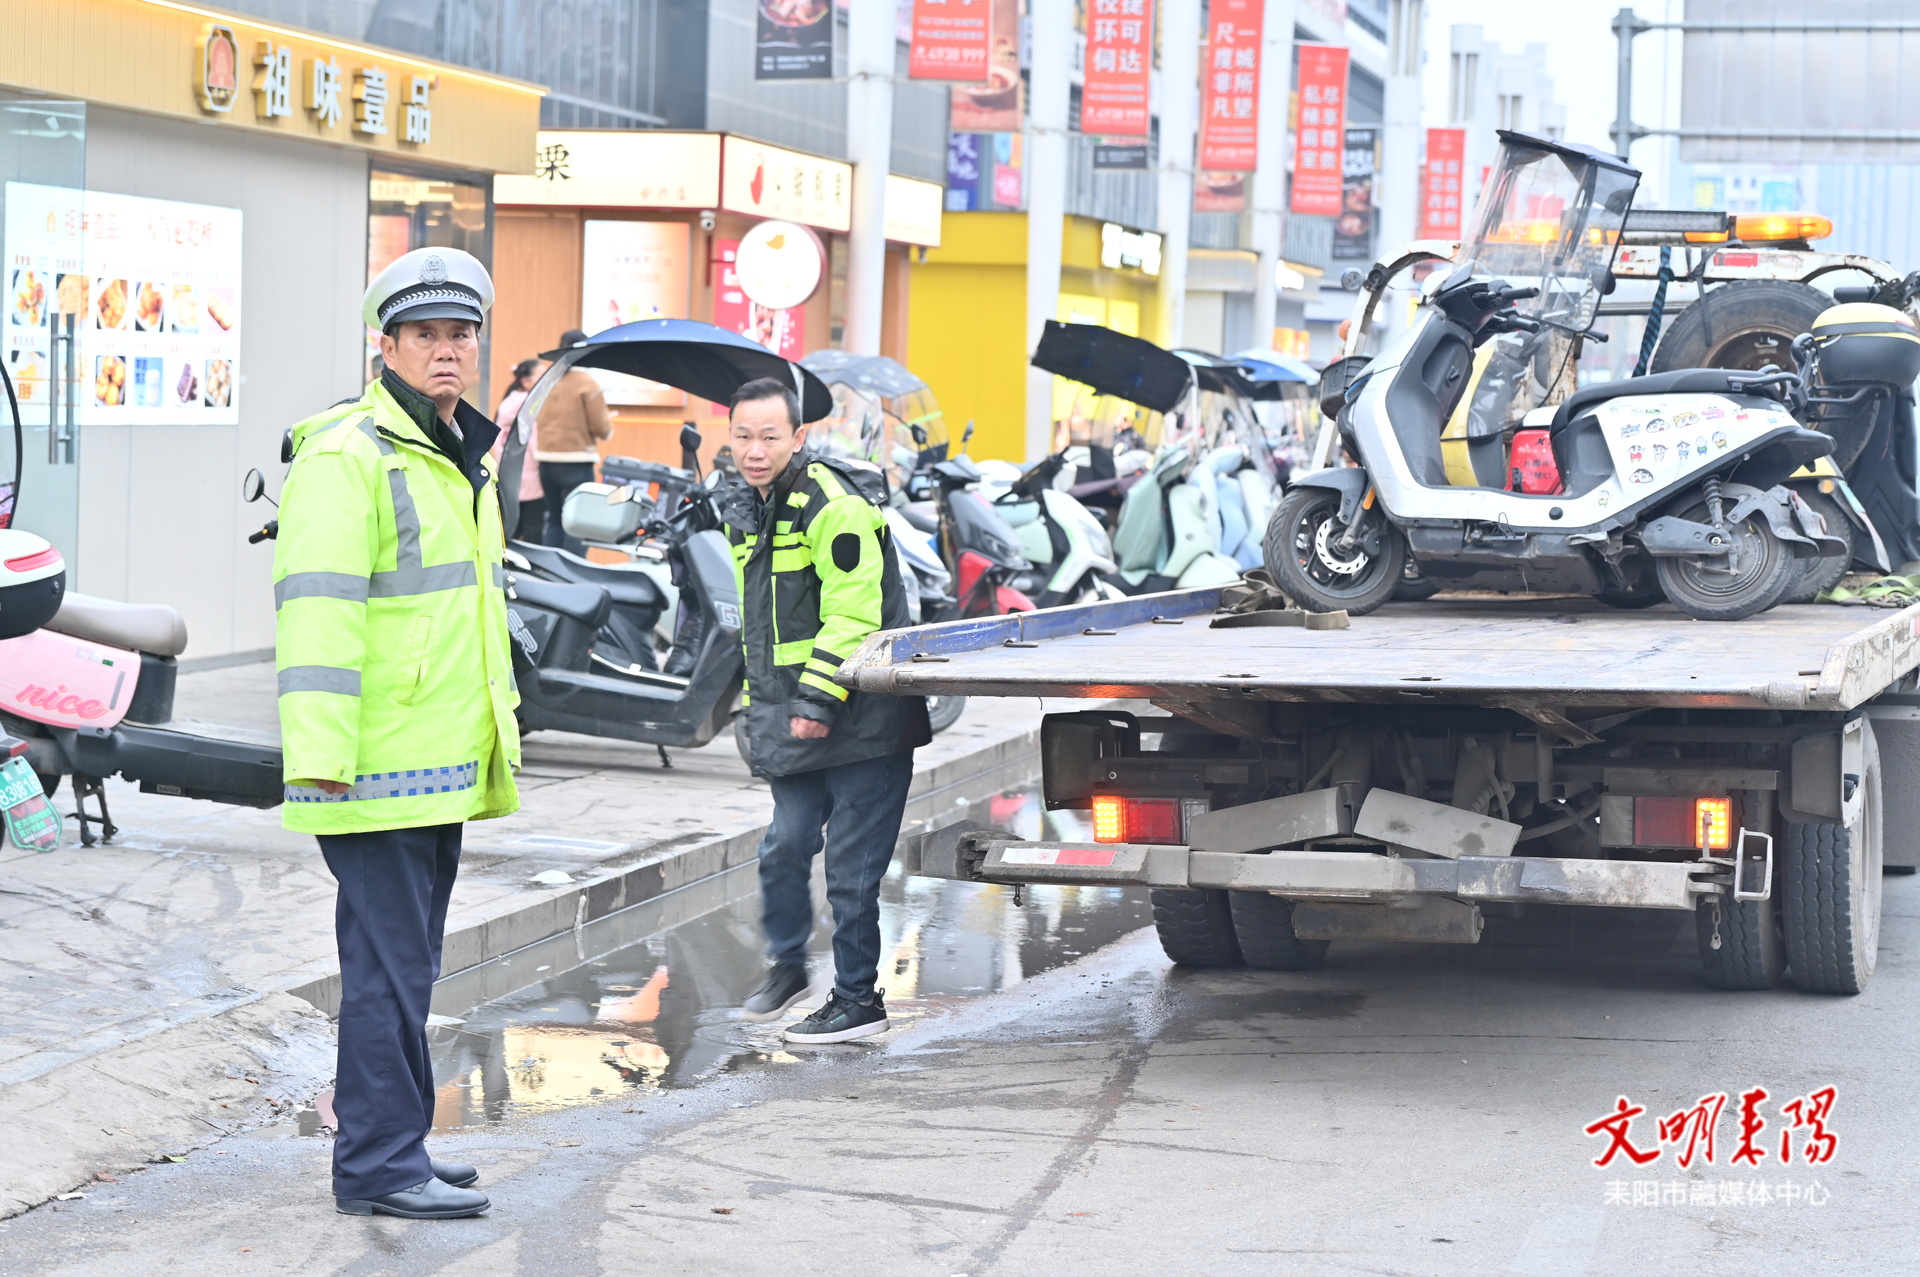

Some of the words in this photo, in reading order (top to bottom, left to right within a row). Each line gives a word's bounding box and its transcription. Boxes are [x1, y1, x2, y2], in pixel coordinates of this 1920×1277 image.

[256, 40, 431, 144] 祖味壹品
[1212, 22, 1235, 118] 尺度非凡
[1233, 29, 1257, 119] 一城所望
[16, 683, 108, 720] nice
